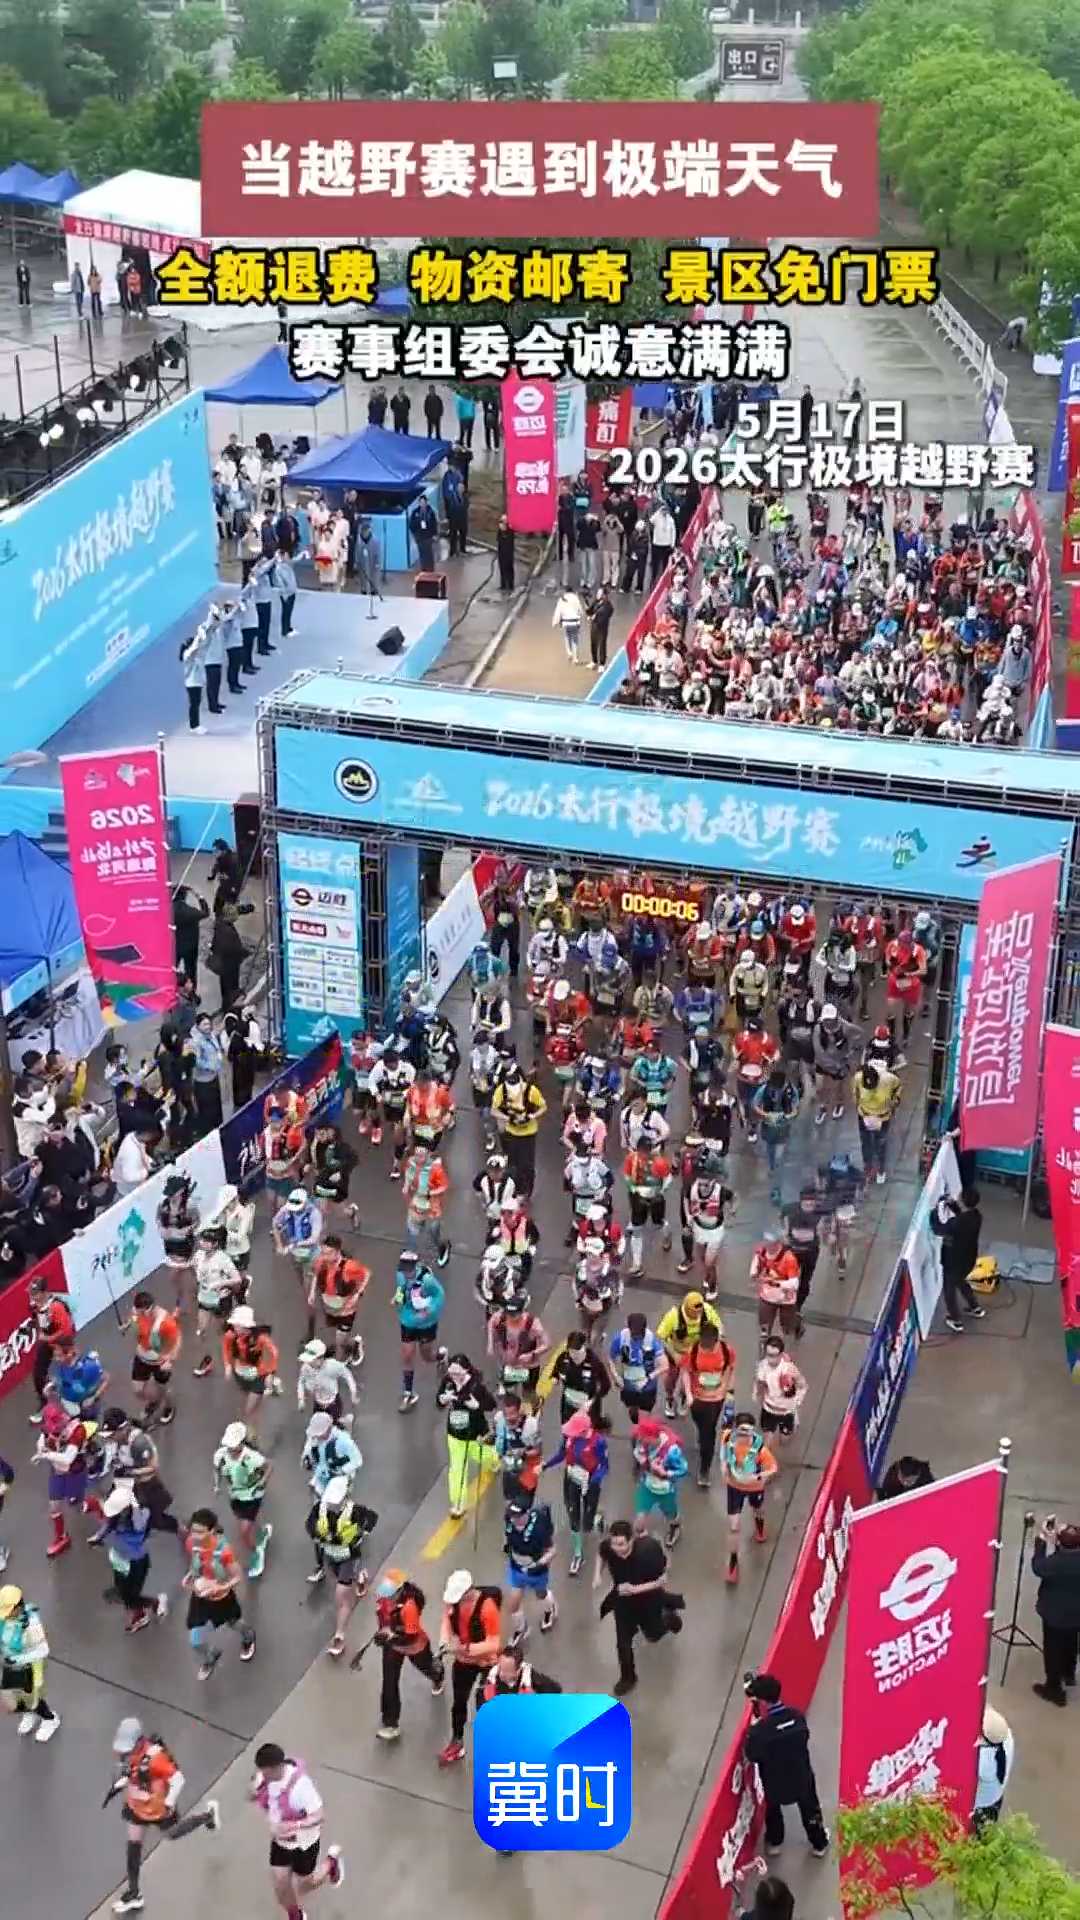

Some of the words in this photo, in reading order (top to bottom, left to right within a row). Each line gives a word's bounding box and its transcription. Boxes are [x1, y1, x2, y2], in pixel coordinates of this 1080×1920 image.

[728, 49, 757, 64] 出口
[485, 779, 842, 862] 2026太行极境越野赛
[621, 893, 699, 922] 00:00:06
